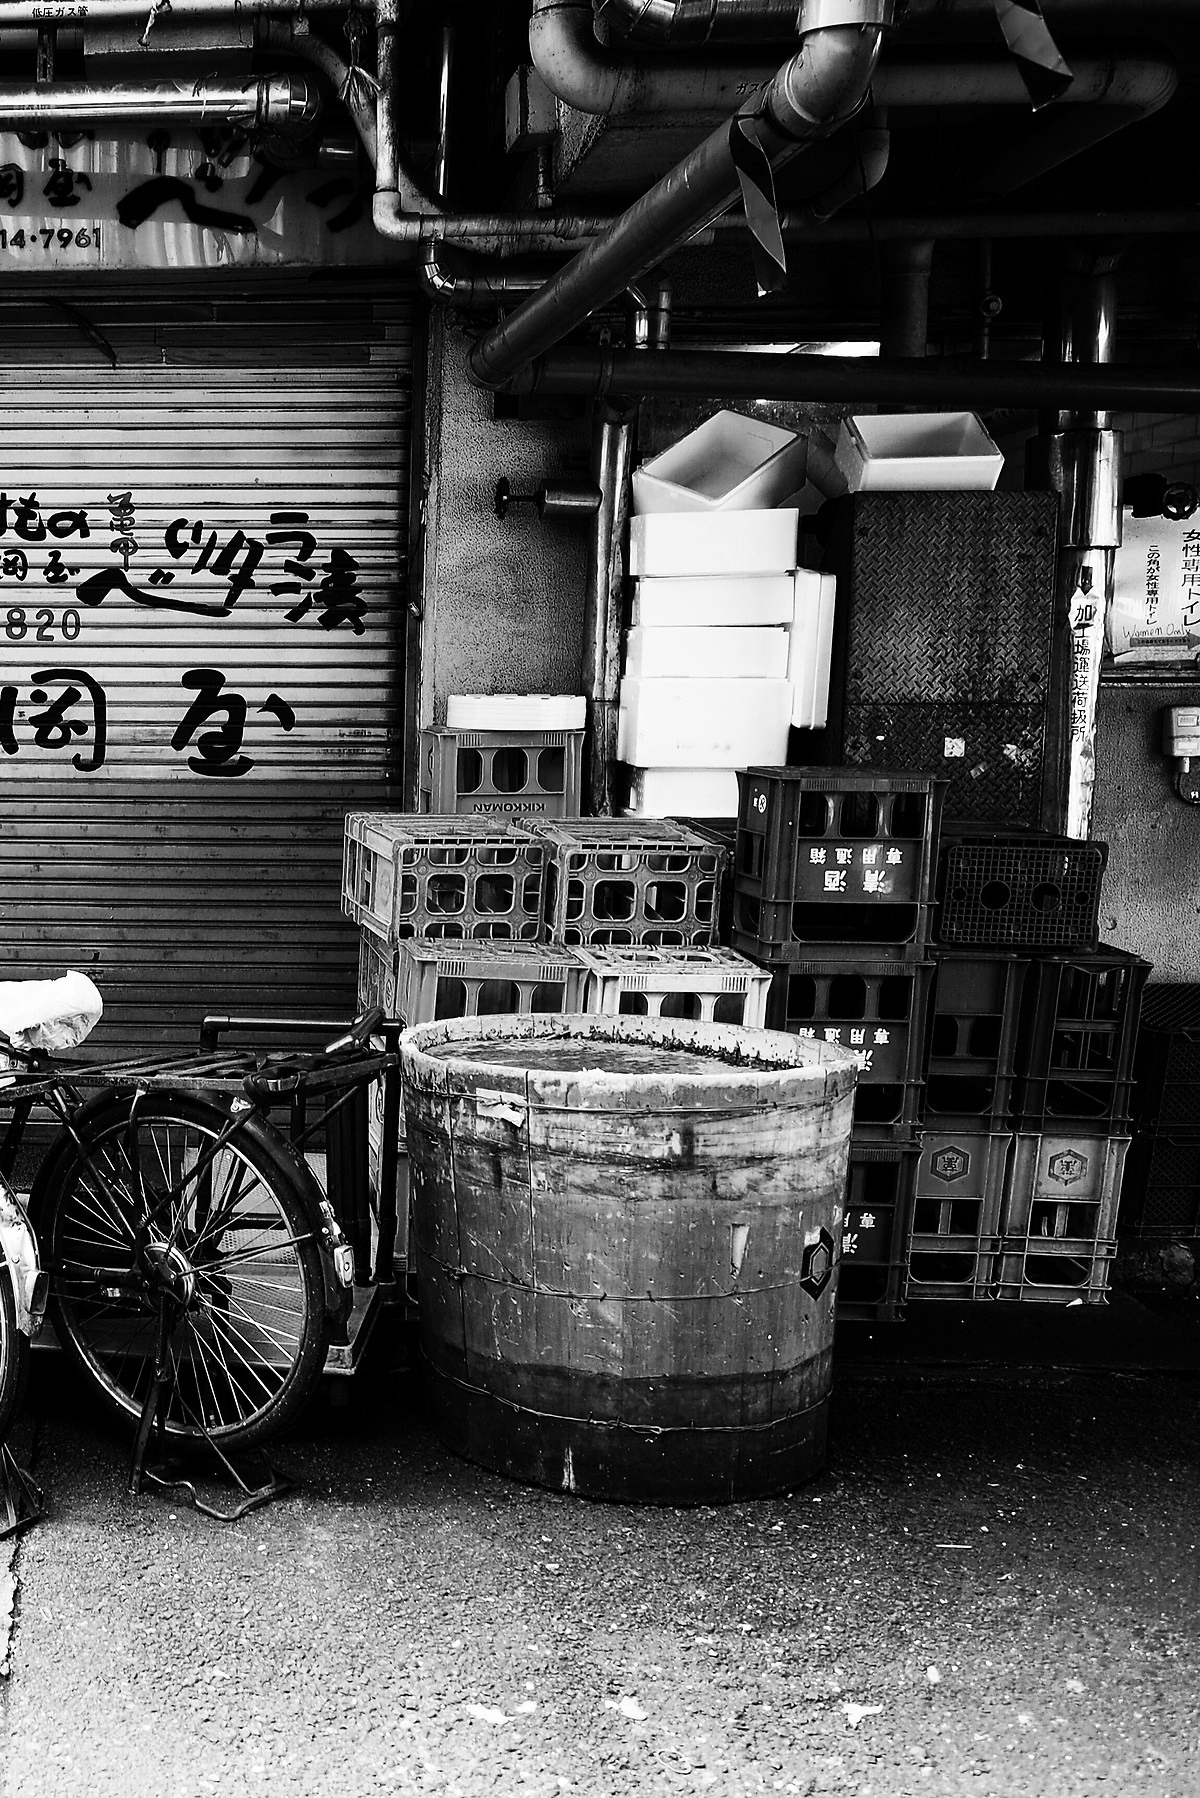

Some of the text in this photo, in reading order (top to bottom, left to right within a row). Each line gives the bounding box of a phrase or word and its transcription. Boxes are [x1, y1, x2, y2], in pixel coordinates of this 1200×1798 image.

[1122, 624, 1163, 639] Women
[473, 802, 545, 812] KIKKOMAN
[822, 869, 886, 893] 清酒
